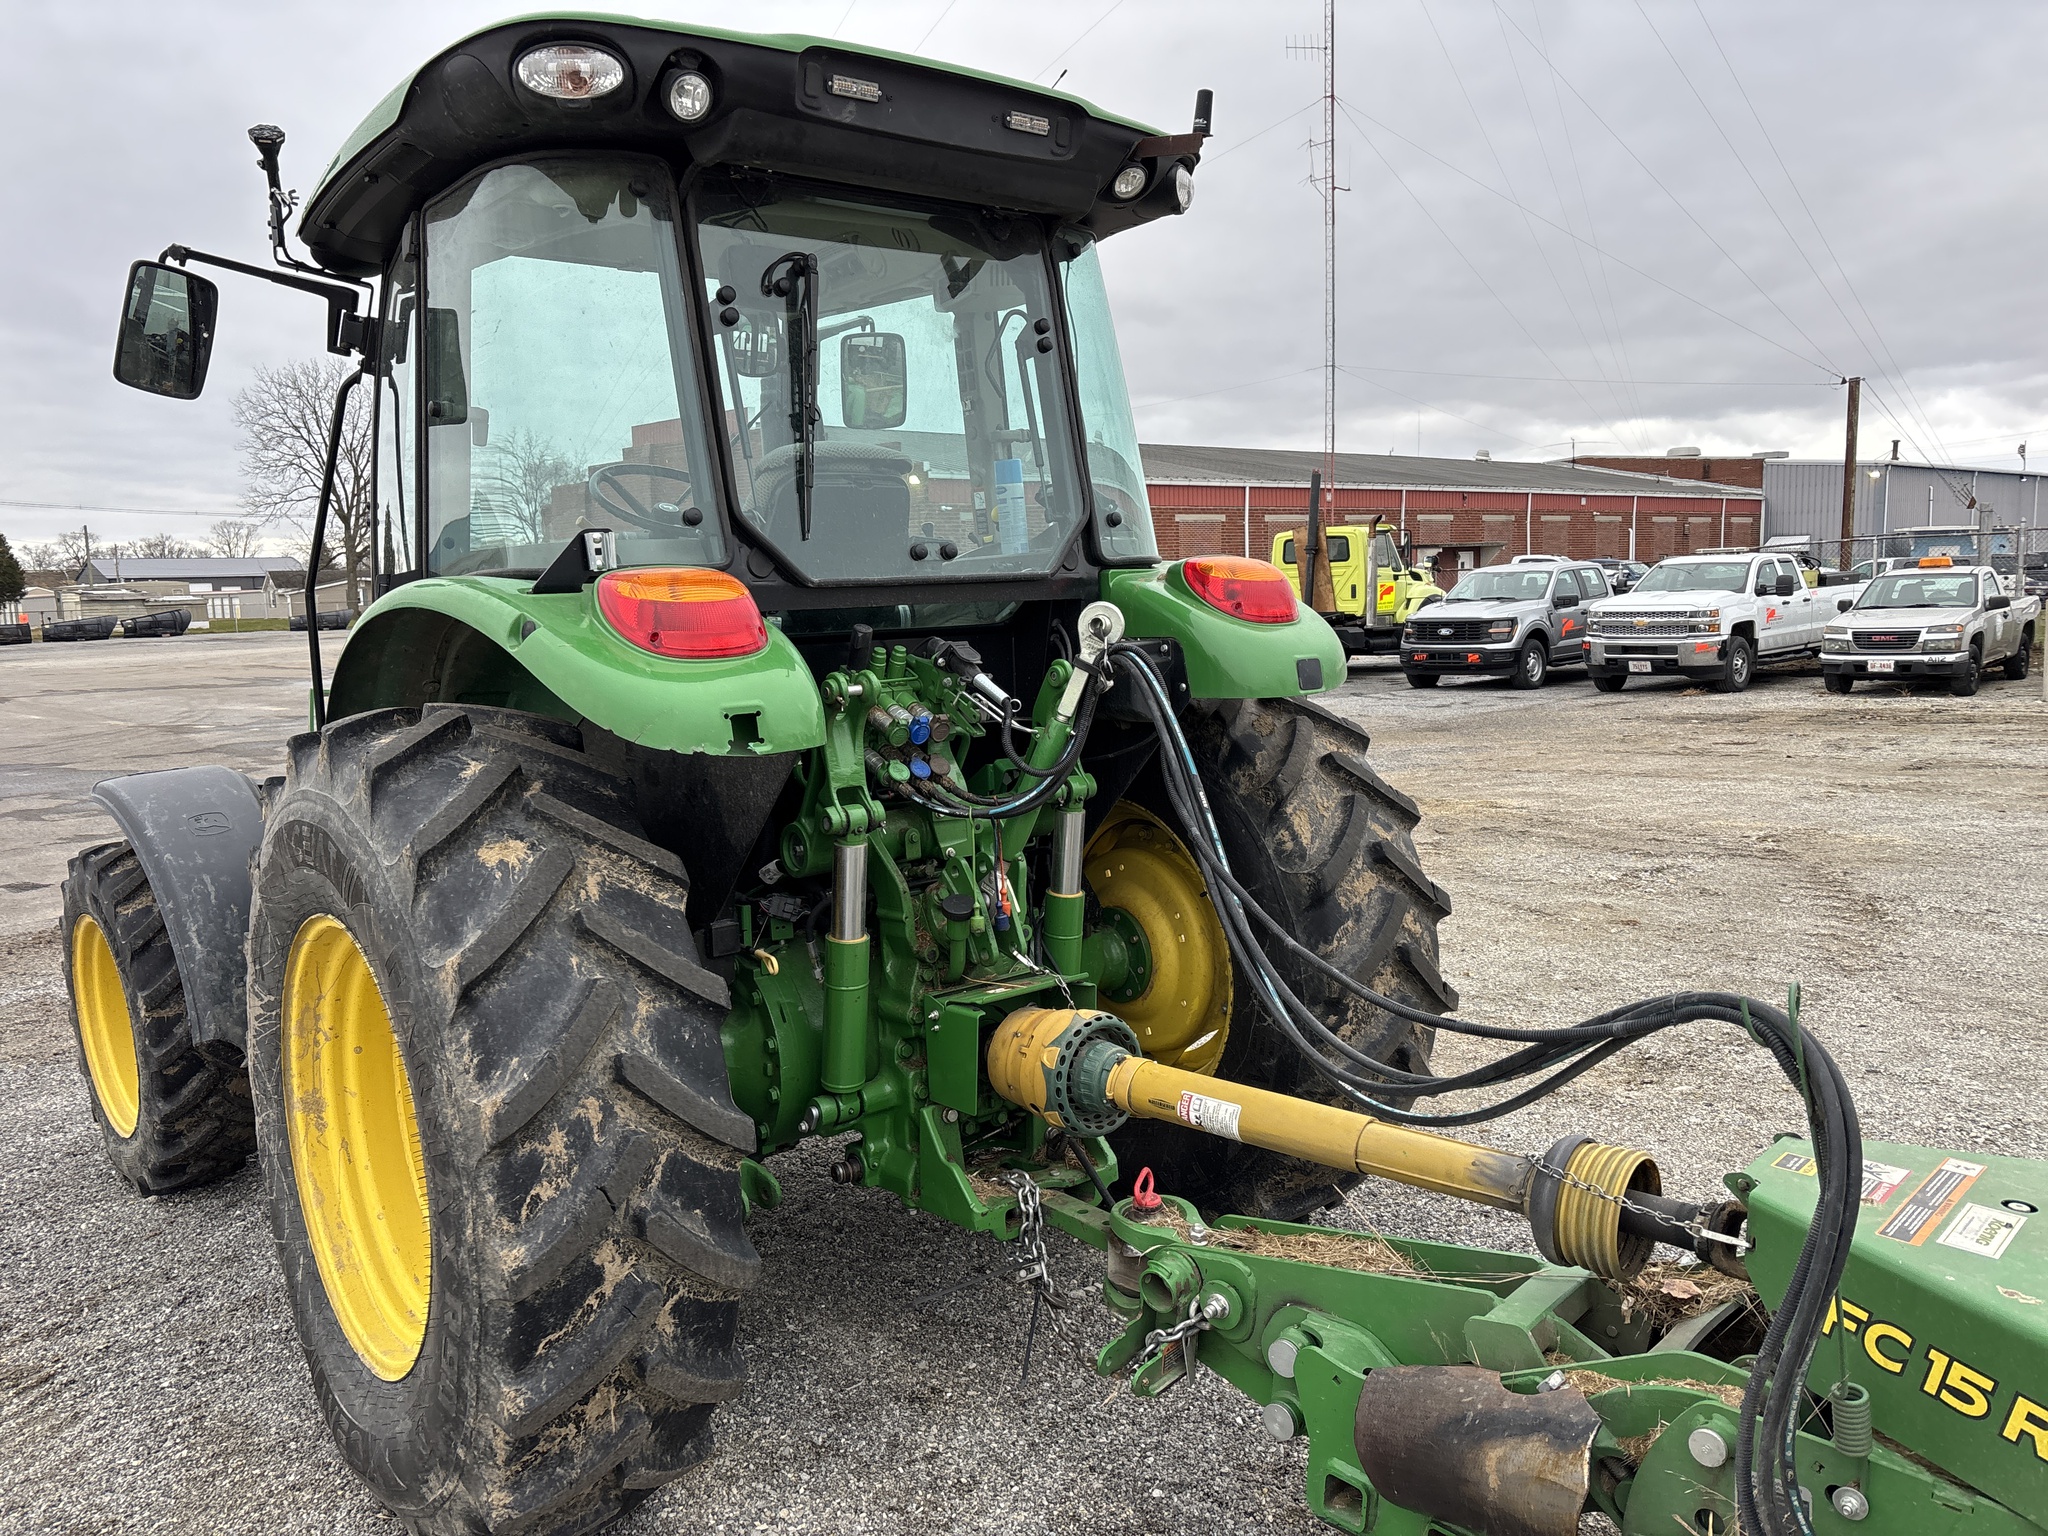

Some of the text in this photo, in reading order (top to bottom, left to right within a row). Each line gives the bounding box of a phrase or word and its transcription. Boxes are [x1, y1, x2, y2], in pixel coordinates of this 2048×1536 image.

[1181, 1093, 1192, 1120] ANGER
[1822, 1294, 1916, 1377] FC
[1919, 1344, 1999, 1420] 15
